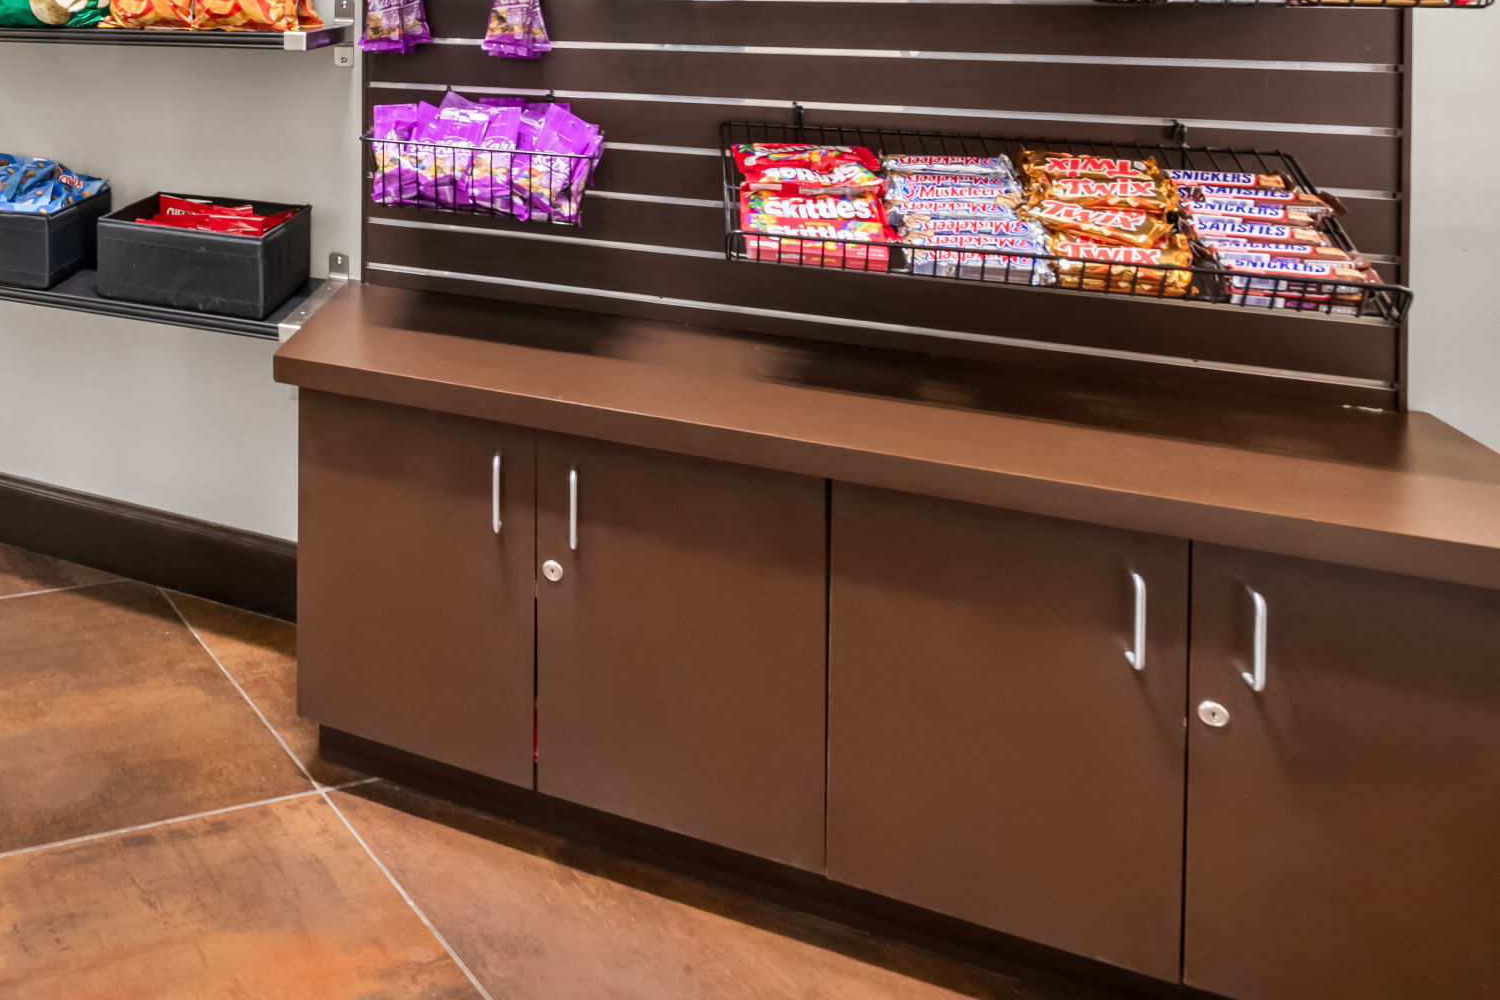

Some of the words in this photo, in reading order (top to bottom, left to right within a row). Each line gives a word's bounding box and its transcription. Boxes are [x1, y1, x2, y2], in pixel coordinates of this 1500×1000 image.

[1047, 158, 1141, 177] Twix
[59, 174, 83, 188] Chex
[1171, 170, 1252, 184] SNICKERS
[903, 185, 918, 198] 3
[919, 185, 1005, 197] Musketeers
[1059, 178, 1156, 196] Twix
[764, 197, 872, 219] Skittles
[1041, 200, 1142, 231] Twix
[923, 220, 1010, 234] Musketeers
[1059, 241, 1161, 265] Twix
